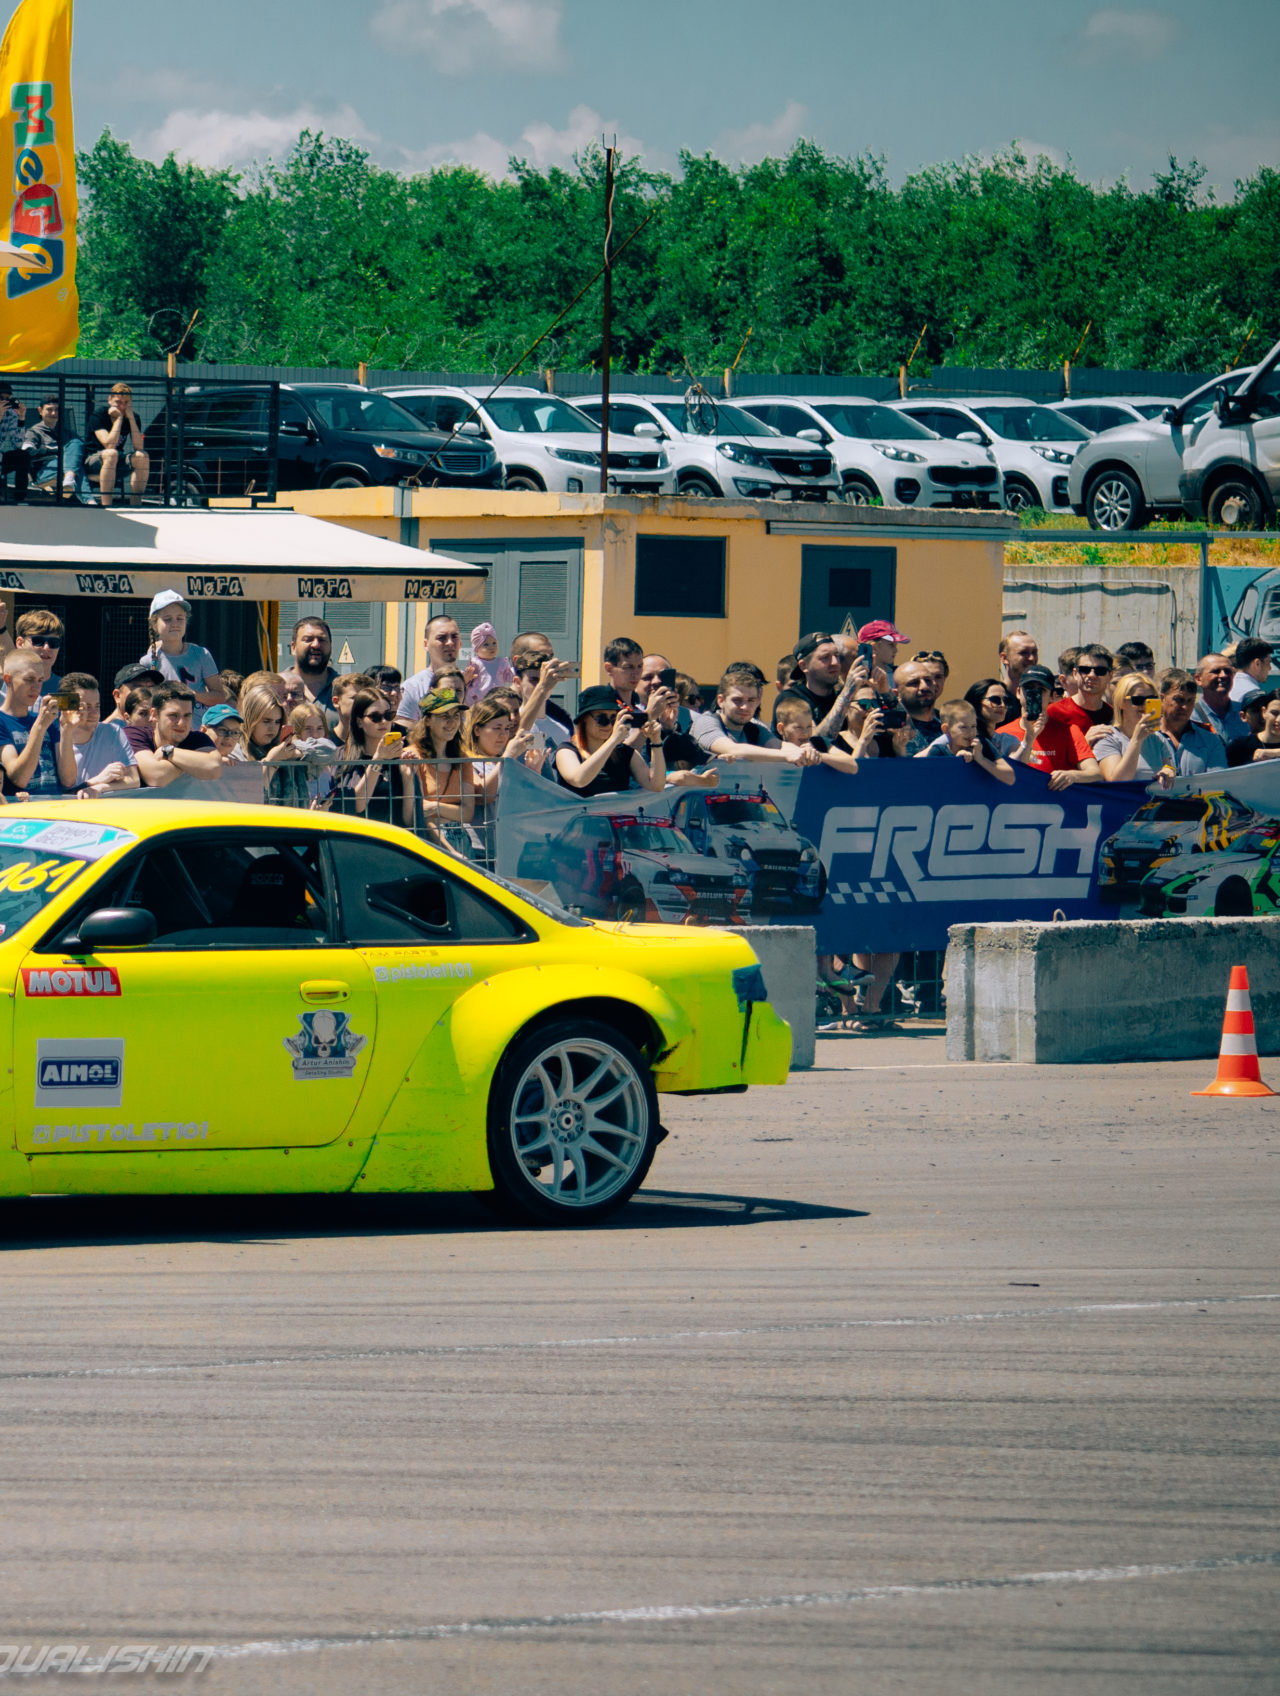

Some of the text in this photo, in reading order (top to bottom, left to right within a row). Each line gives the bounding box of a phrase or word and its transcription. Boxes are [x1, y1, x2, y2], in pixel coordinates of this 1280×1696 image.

[29, 970, 117, 993] MOTUL
[42, 1064, 116, 1082] AIMOL
[52, 1121, 209, 1143] PISTOLET101
